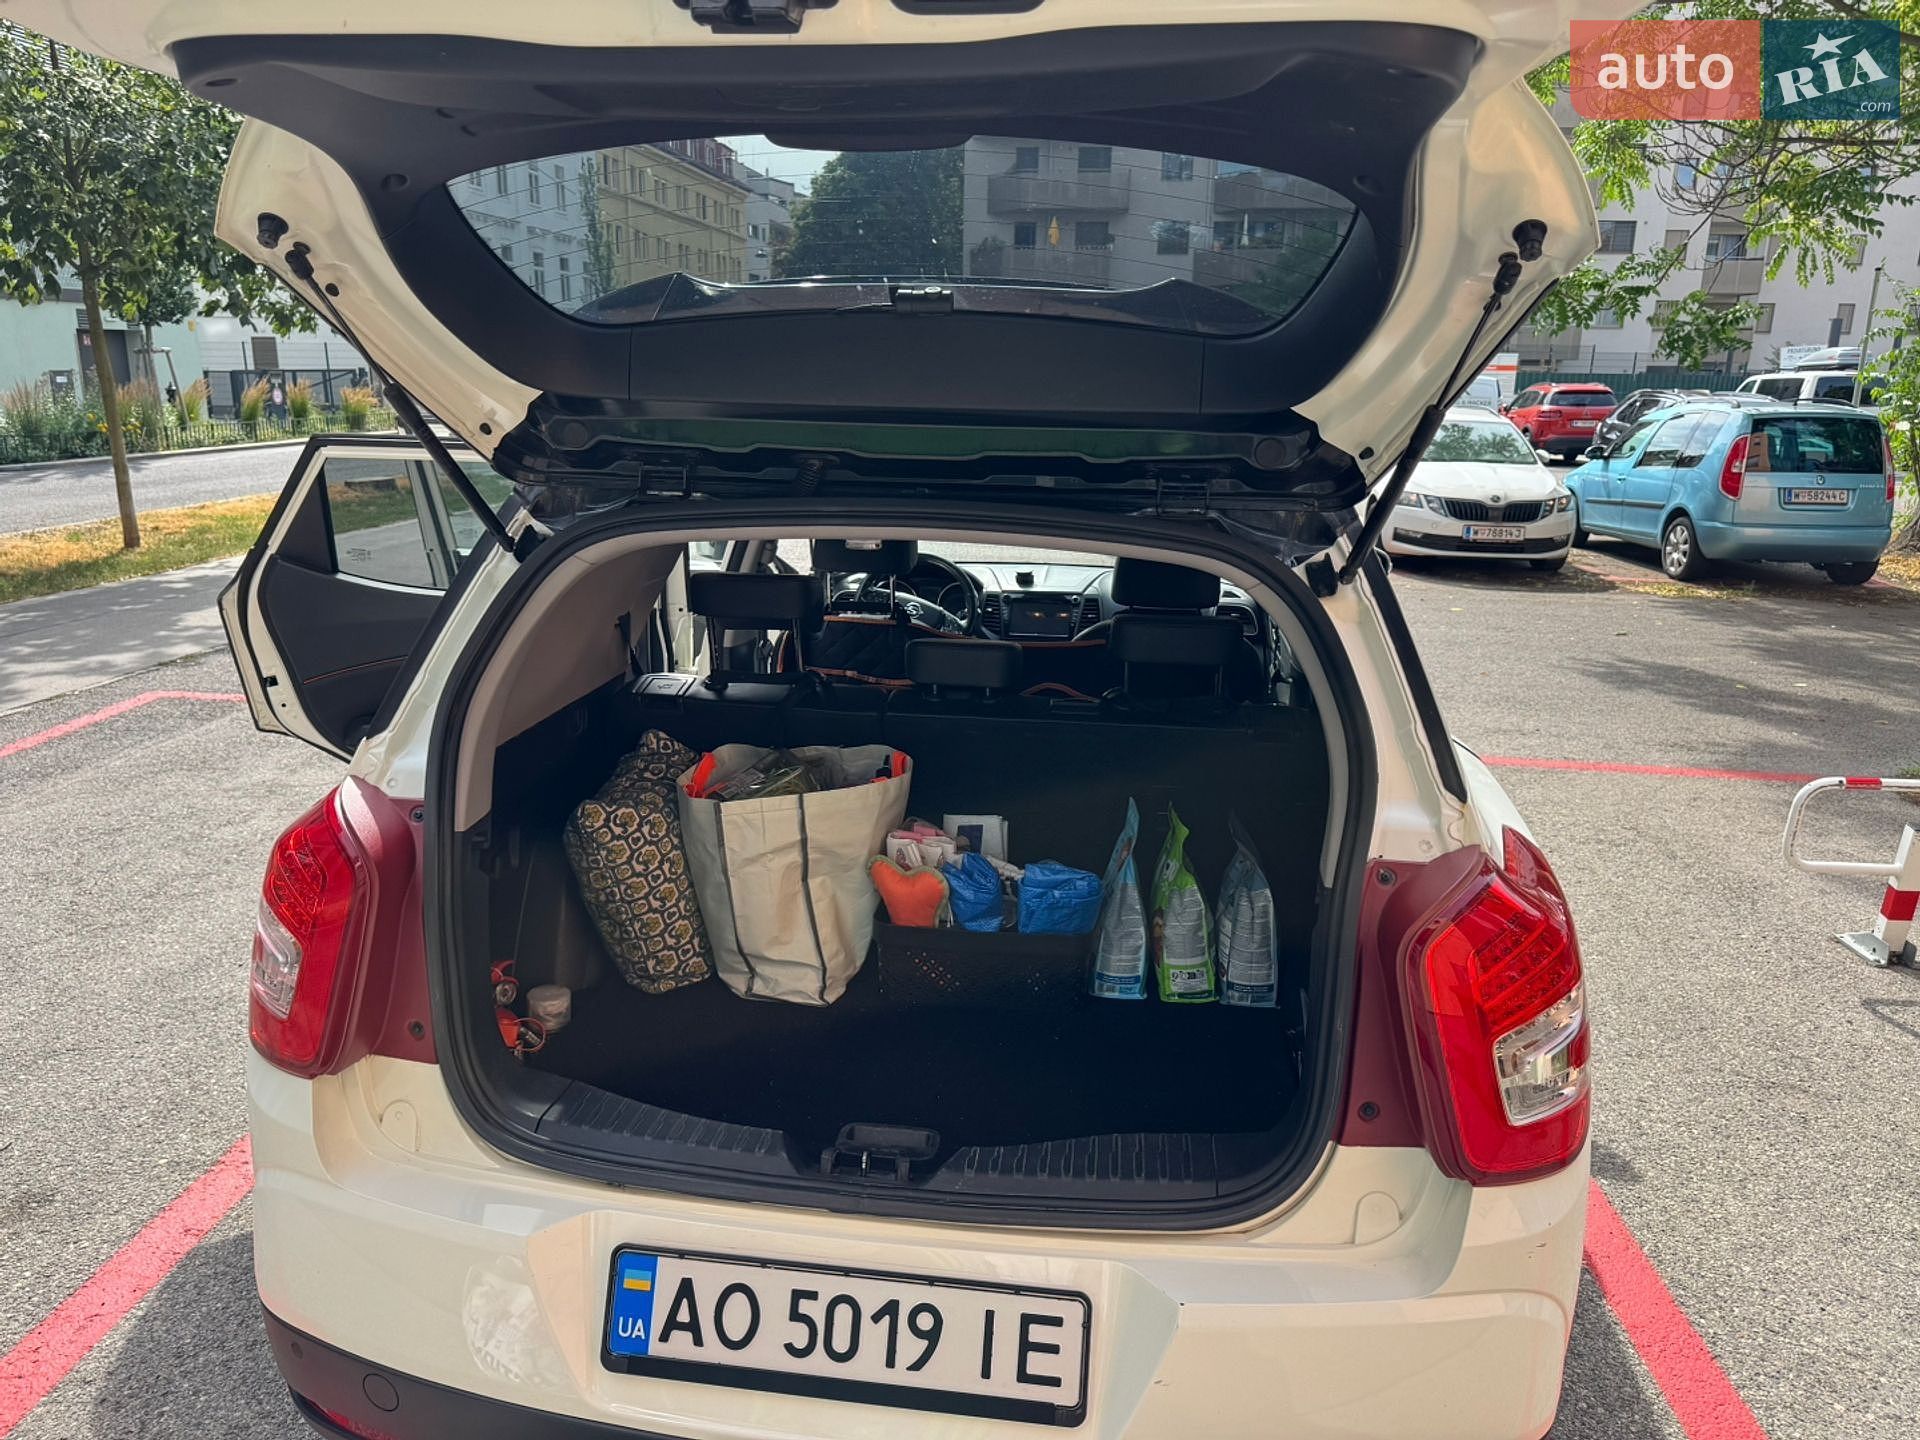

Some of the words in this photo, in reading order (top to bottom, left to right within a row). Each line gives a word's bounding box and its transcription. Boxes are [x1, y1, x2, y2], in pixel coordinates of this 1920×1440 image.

[1807, 490, 1836, 502] 58244
[618, 1316, 646, 1340] UA
[658, 1277, 761, 1351] AO
[784, 1288, 944, 1372] 5019
[980, 1308, 1064, 1388] IE
